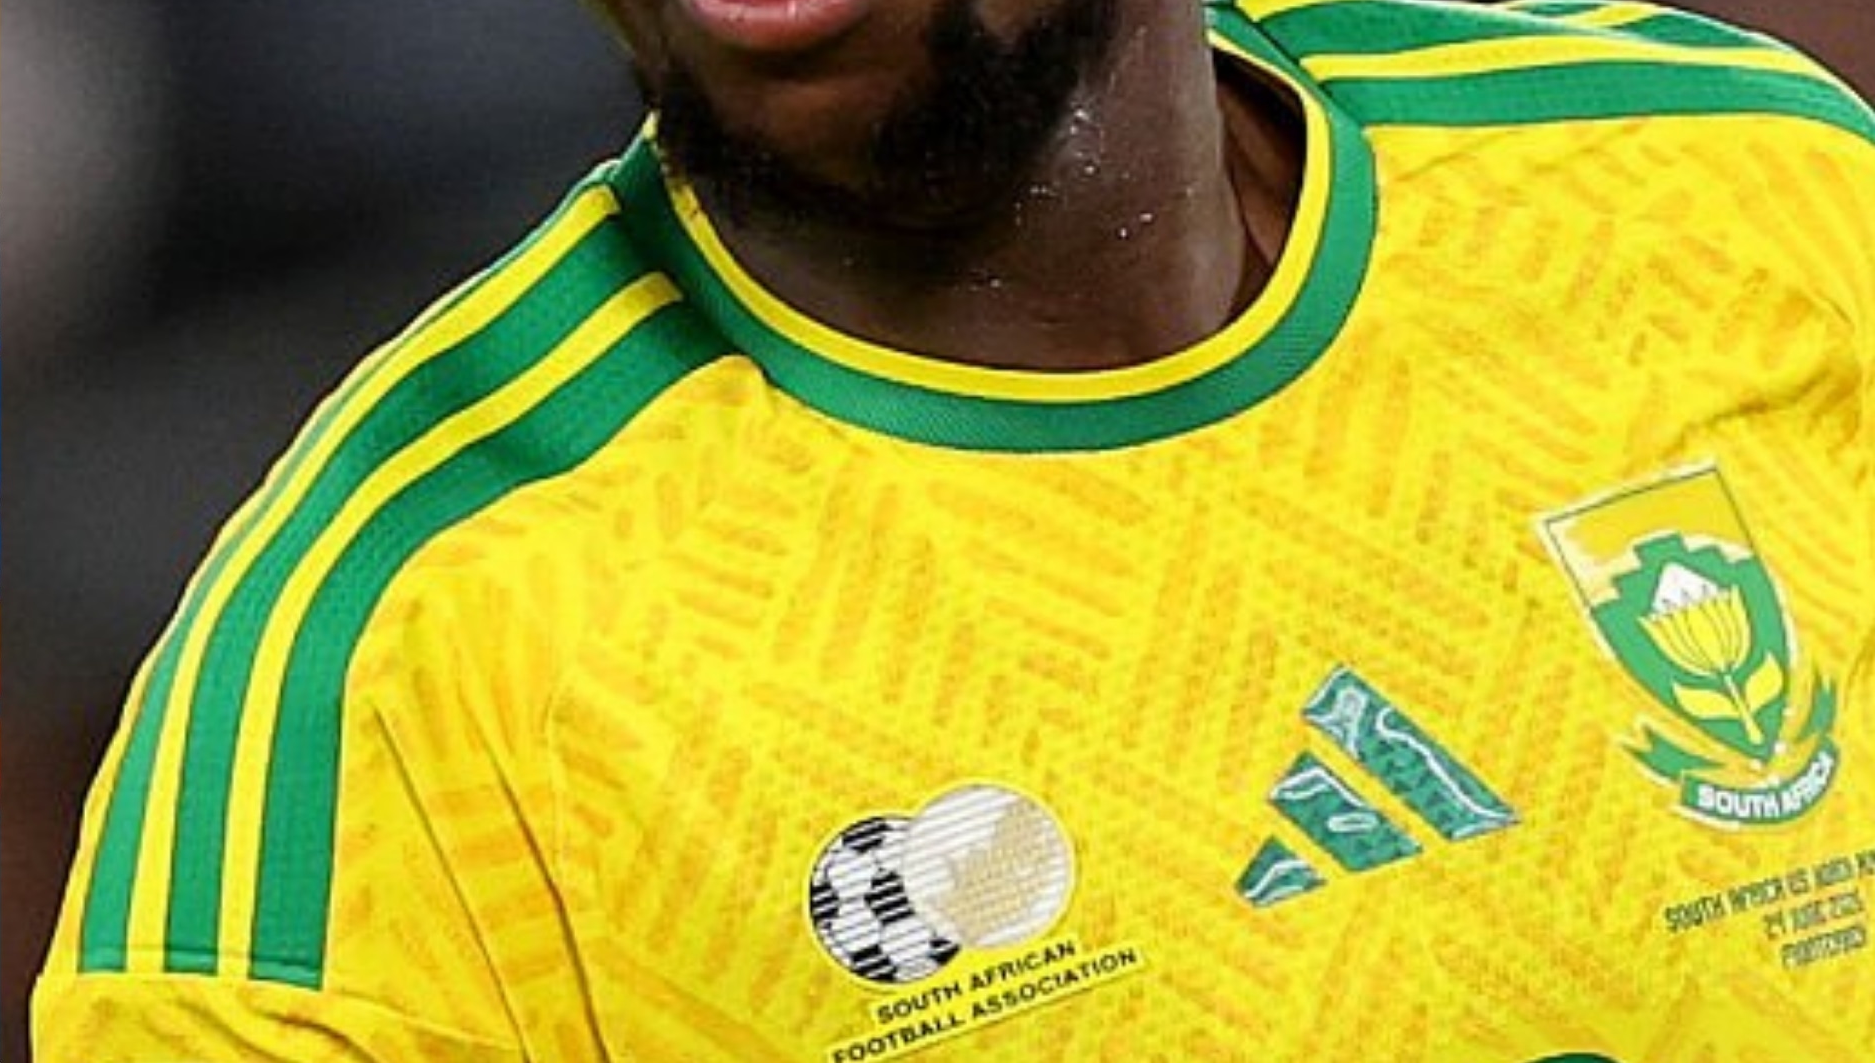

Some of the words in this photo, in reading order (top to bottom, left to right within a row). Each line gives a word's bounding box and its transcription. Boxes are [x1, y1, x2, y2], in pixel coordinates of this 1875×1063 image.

[1697, 783, 1781, 819] SOUTH
[1781, 750, 1835, 815] AFRICA
[833, 1012, 965, 1063] FOOTBALL
[971, 947, 1137, 1019] ASSOCIATION
[876, 980, 962, 1024] SOUTH
[969, 939, 1076, 990] AFRICAN
